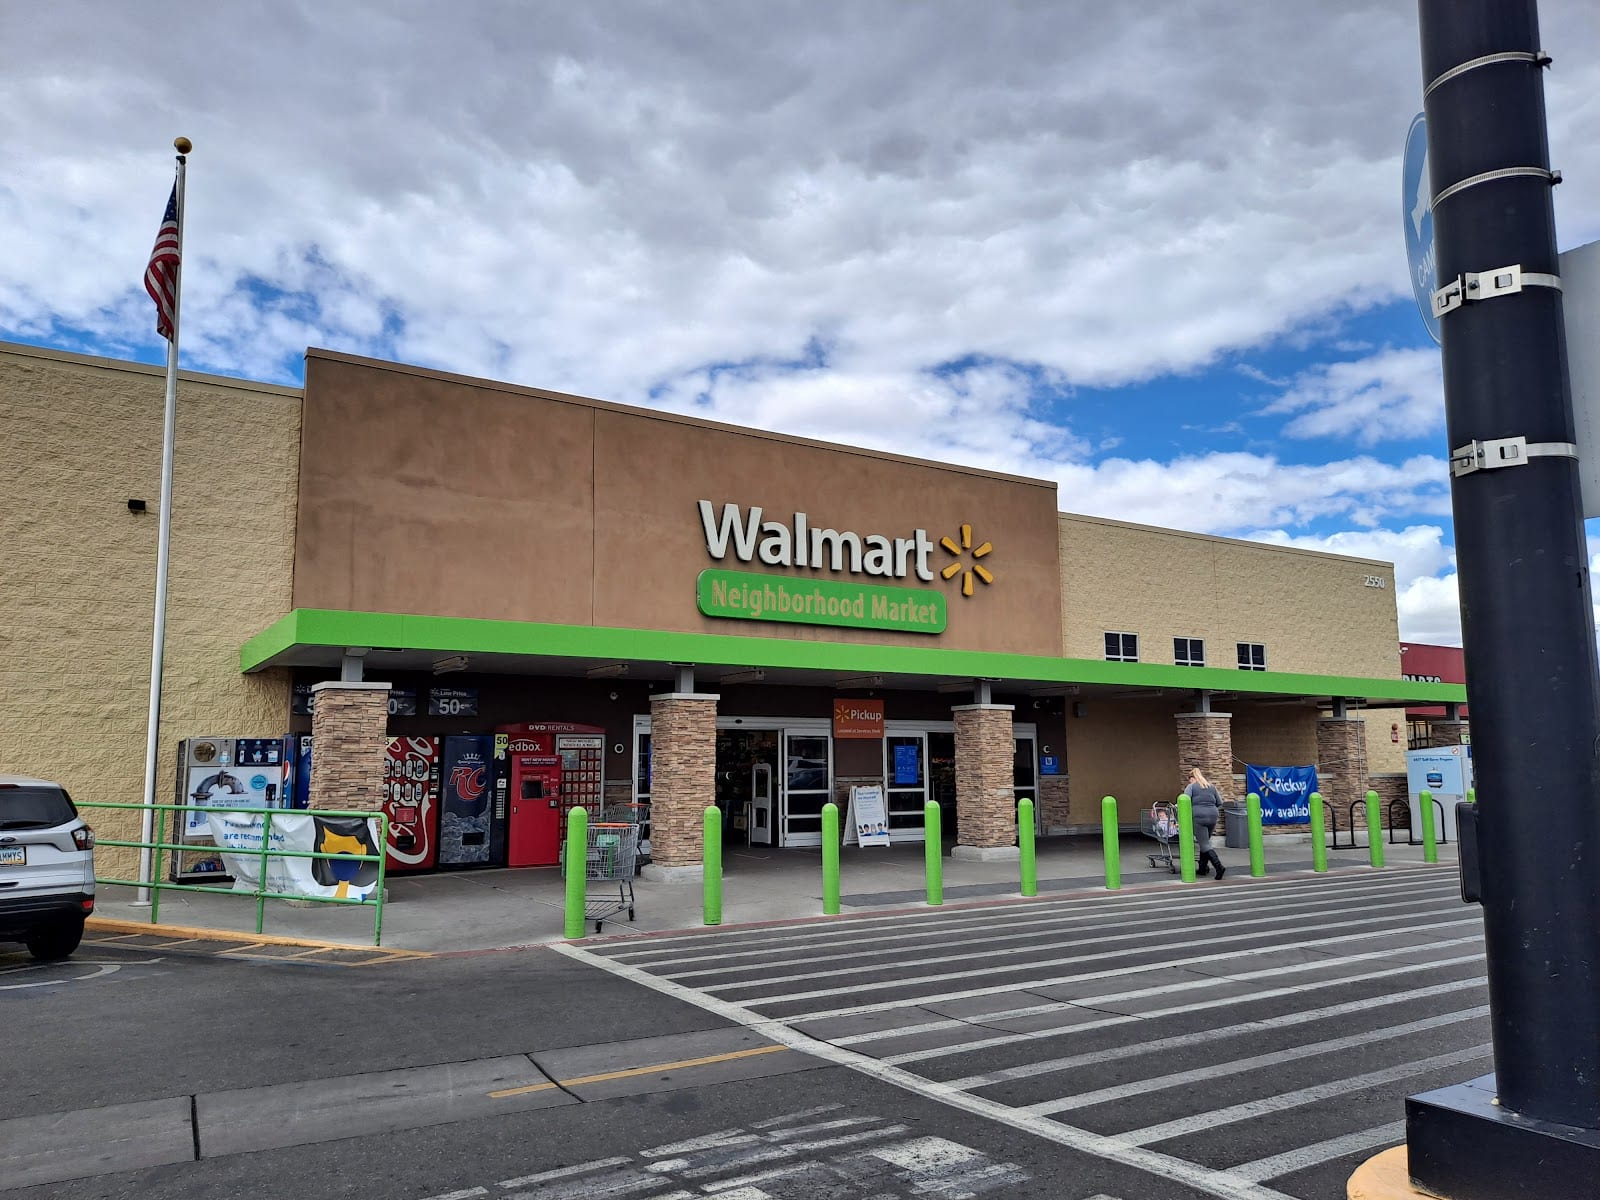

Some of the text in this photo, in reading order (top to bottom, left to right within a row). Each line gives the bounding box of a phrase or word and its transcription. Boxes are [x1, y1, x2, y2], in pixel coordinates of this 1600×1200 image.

[698, 500, 934, 581] Walmart
[1364, 575, 1385, 588] 2550
[712, 579, 938, 625] Neighborhood Market
[851, 710, 882, 723] Pickup
[509, 742, 540, 751] edbox
[1274, 778, 1307, 795] Pickup
[1277, 803, 1311, 818] availabl
